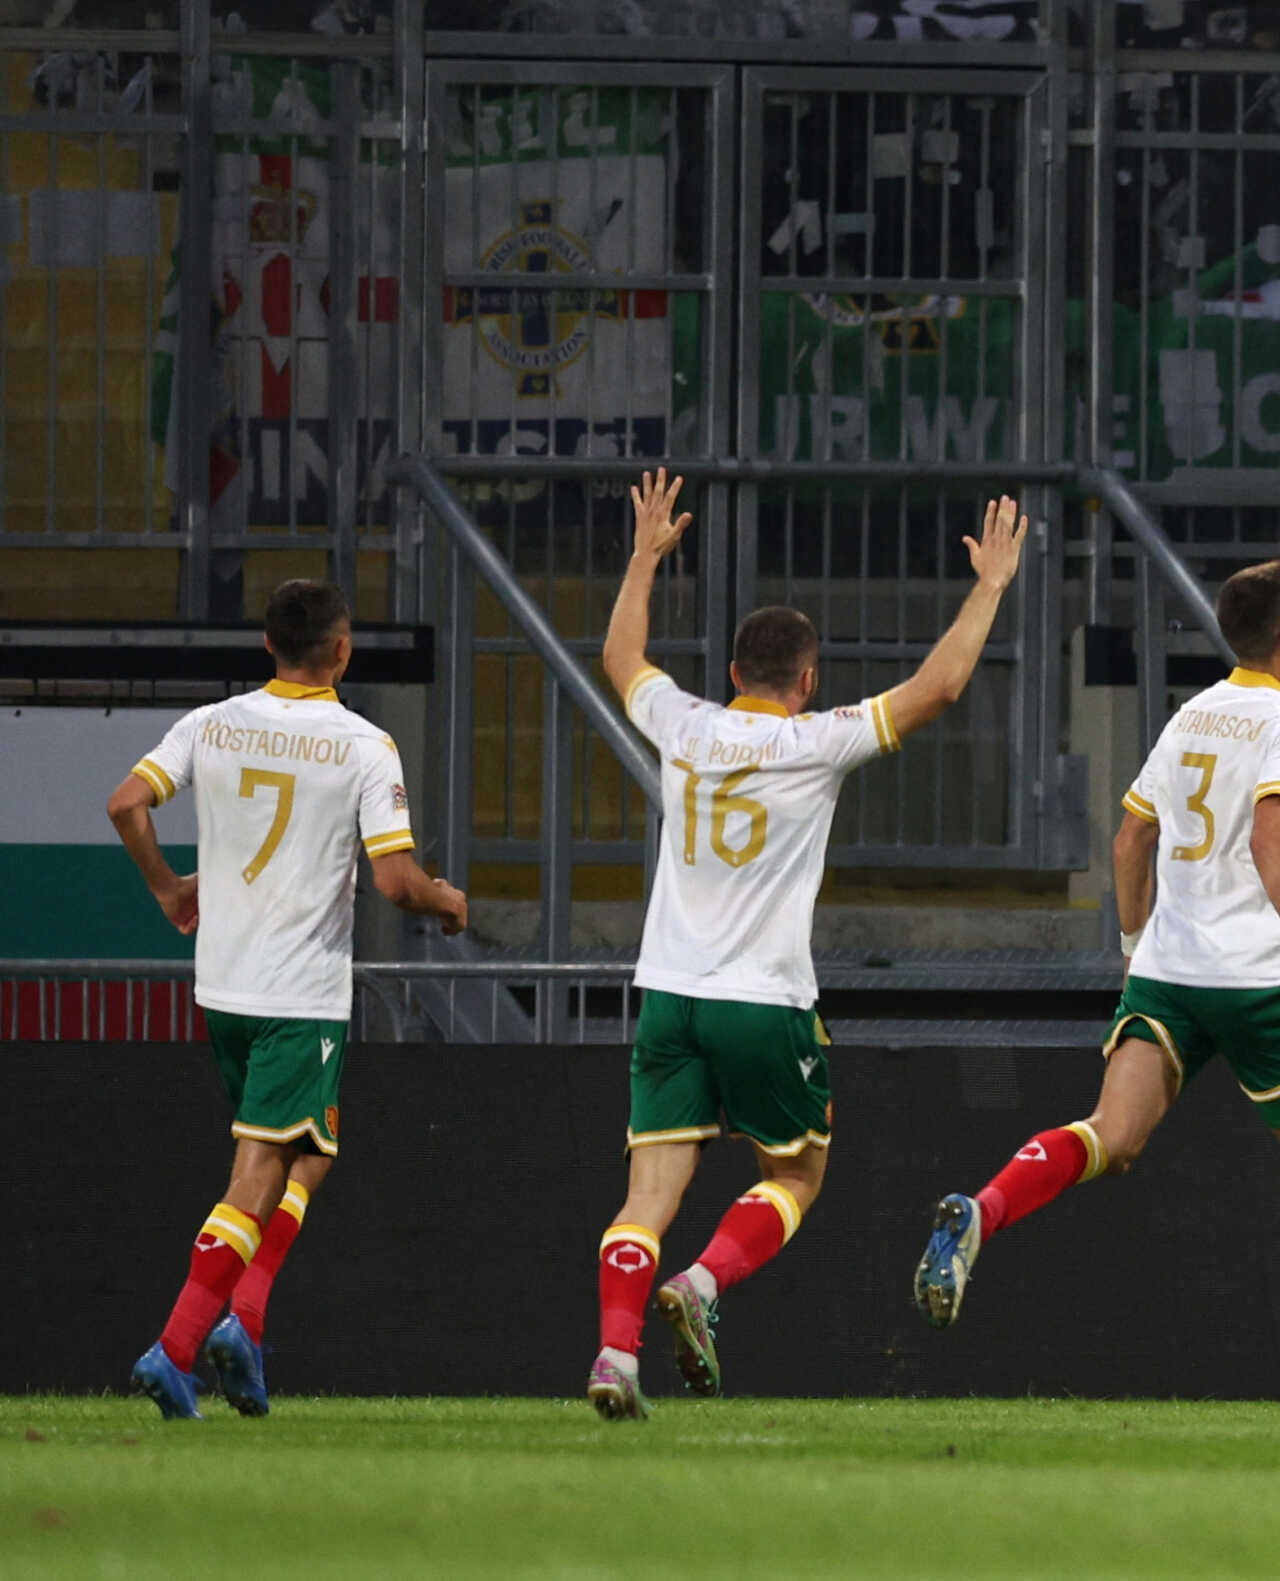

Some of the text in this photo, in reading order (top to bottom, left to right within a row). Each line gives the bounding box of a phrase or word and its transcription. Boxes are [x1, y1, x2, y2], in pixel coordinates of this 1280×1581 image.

[201, 719, 352, 767] KOSTADINOV
[239, 767, 297, 886] 7
[671, 759, 769, 869] 16
[1171, 751, 1218, 861] 3
